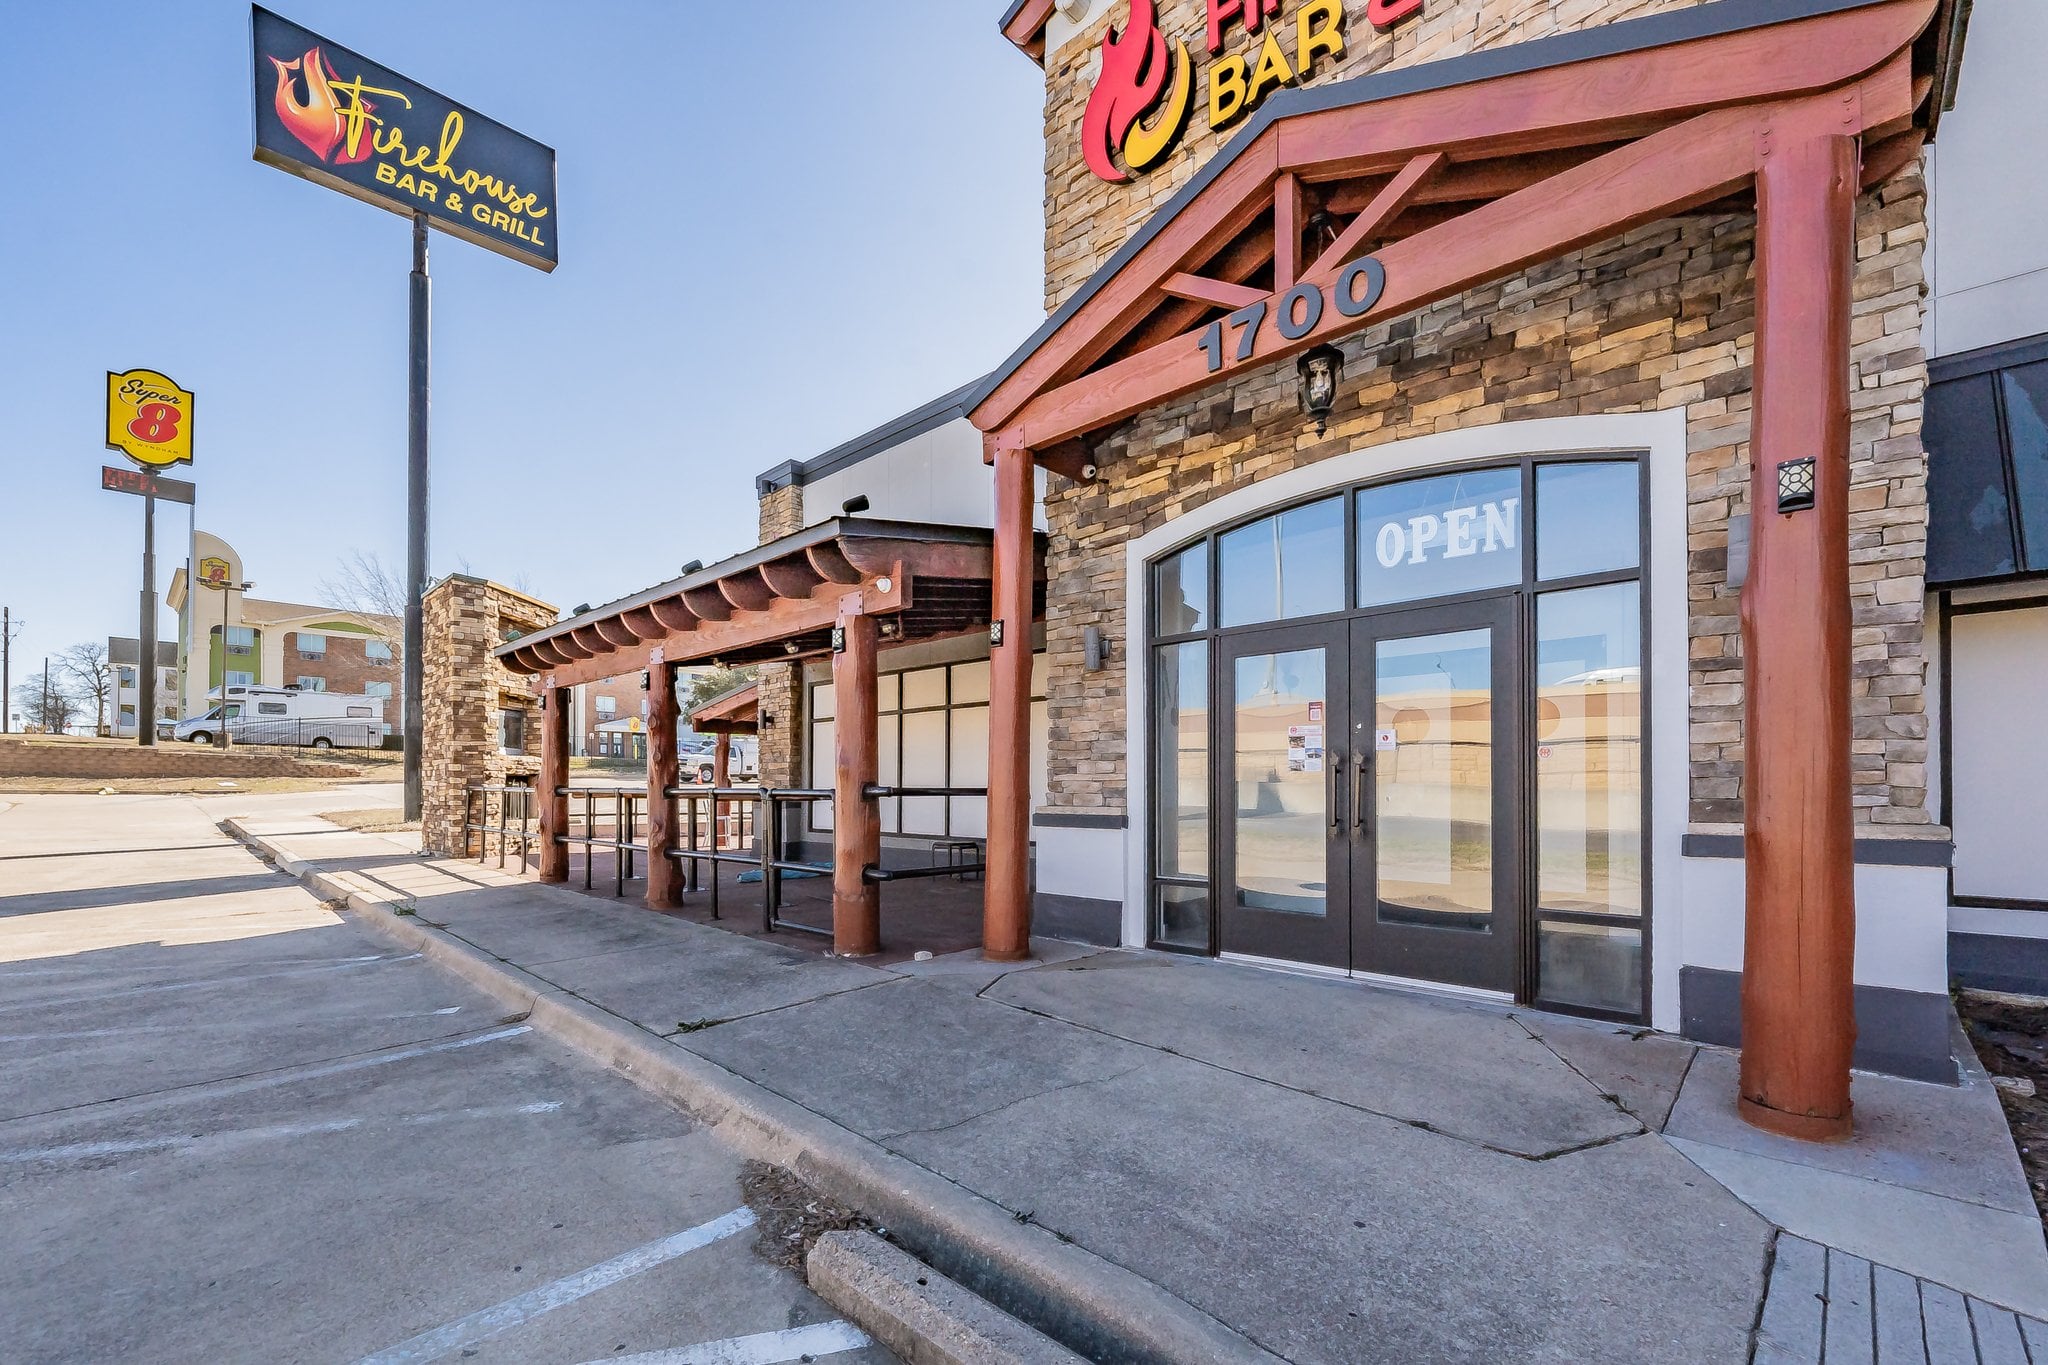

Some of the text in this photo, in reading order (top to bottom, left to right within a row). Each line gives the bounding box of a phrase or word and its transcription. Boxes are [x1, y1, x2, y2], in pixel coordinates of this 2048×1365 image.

[1208, 0, 1344, 129] BAR
[327, 75, 548, 218] Firehouse
[375, 162, 545, 246] BAR & GRILL
[1198, 256, 1386, 373] 1700
[119, 379, 182, 404] Super
[127, 402, 182, 443] 8
[1375, 497, 1520, 568] OPEN
